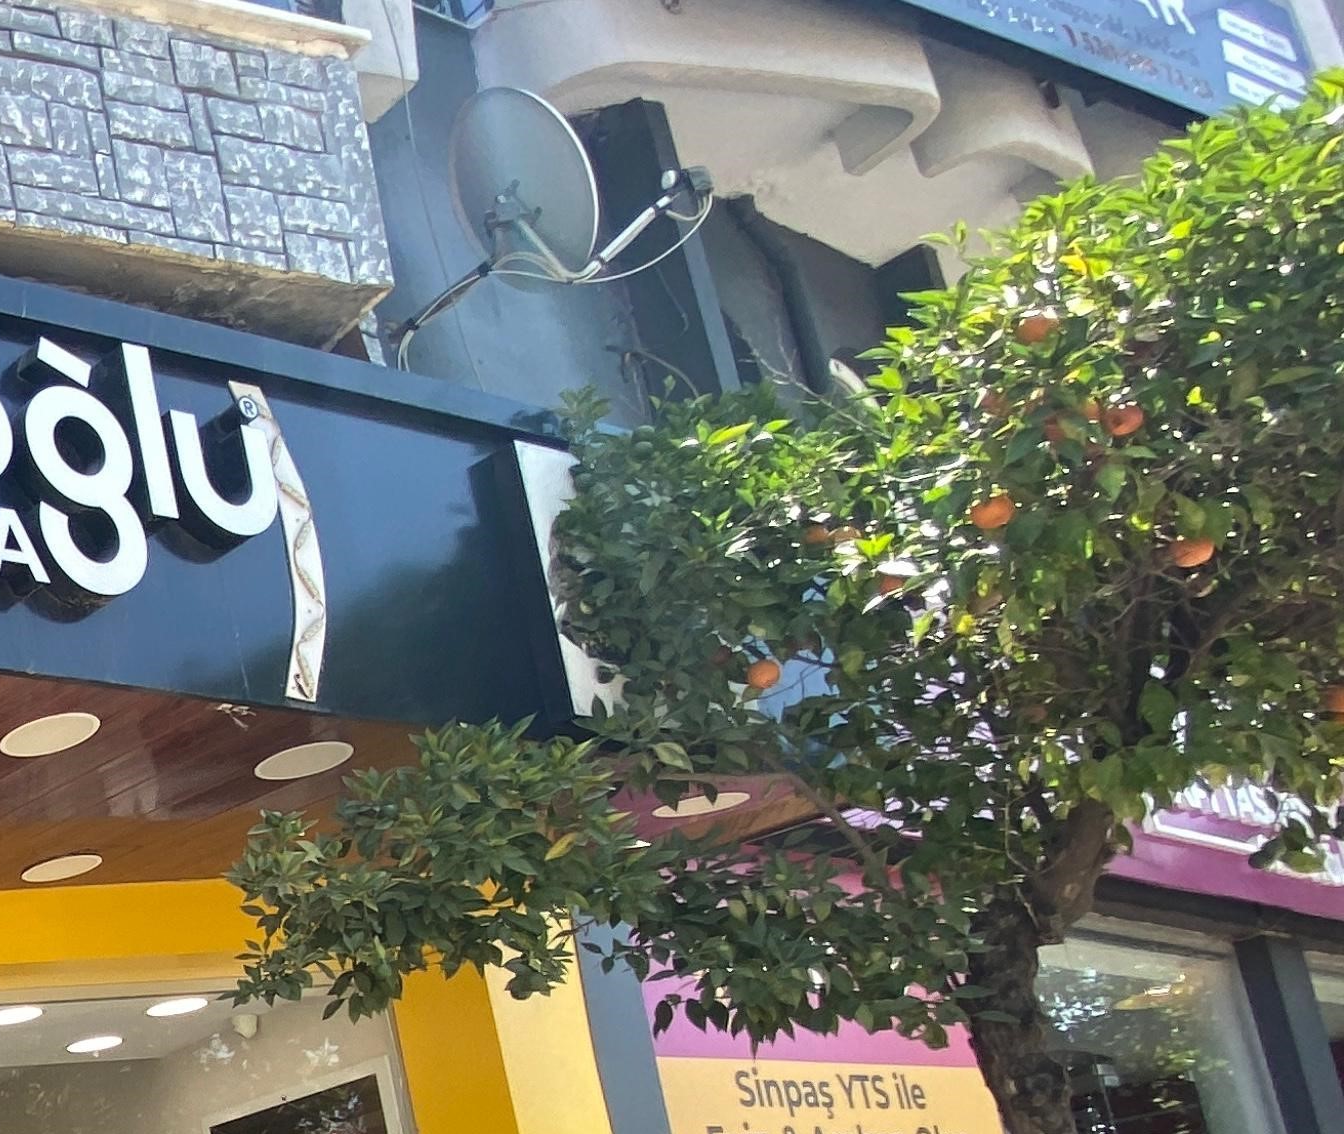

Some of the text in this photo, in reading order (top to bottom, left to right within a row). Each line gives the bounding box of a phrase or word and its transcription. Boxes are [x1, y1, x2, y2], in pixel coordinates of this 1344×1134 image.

[735, 1067, 927, 1120] Sinpaş YTS ile
